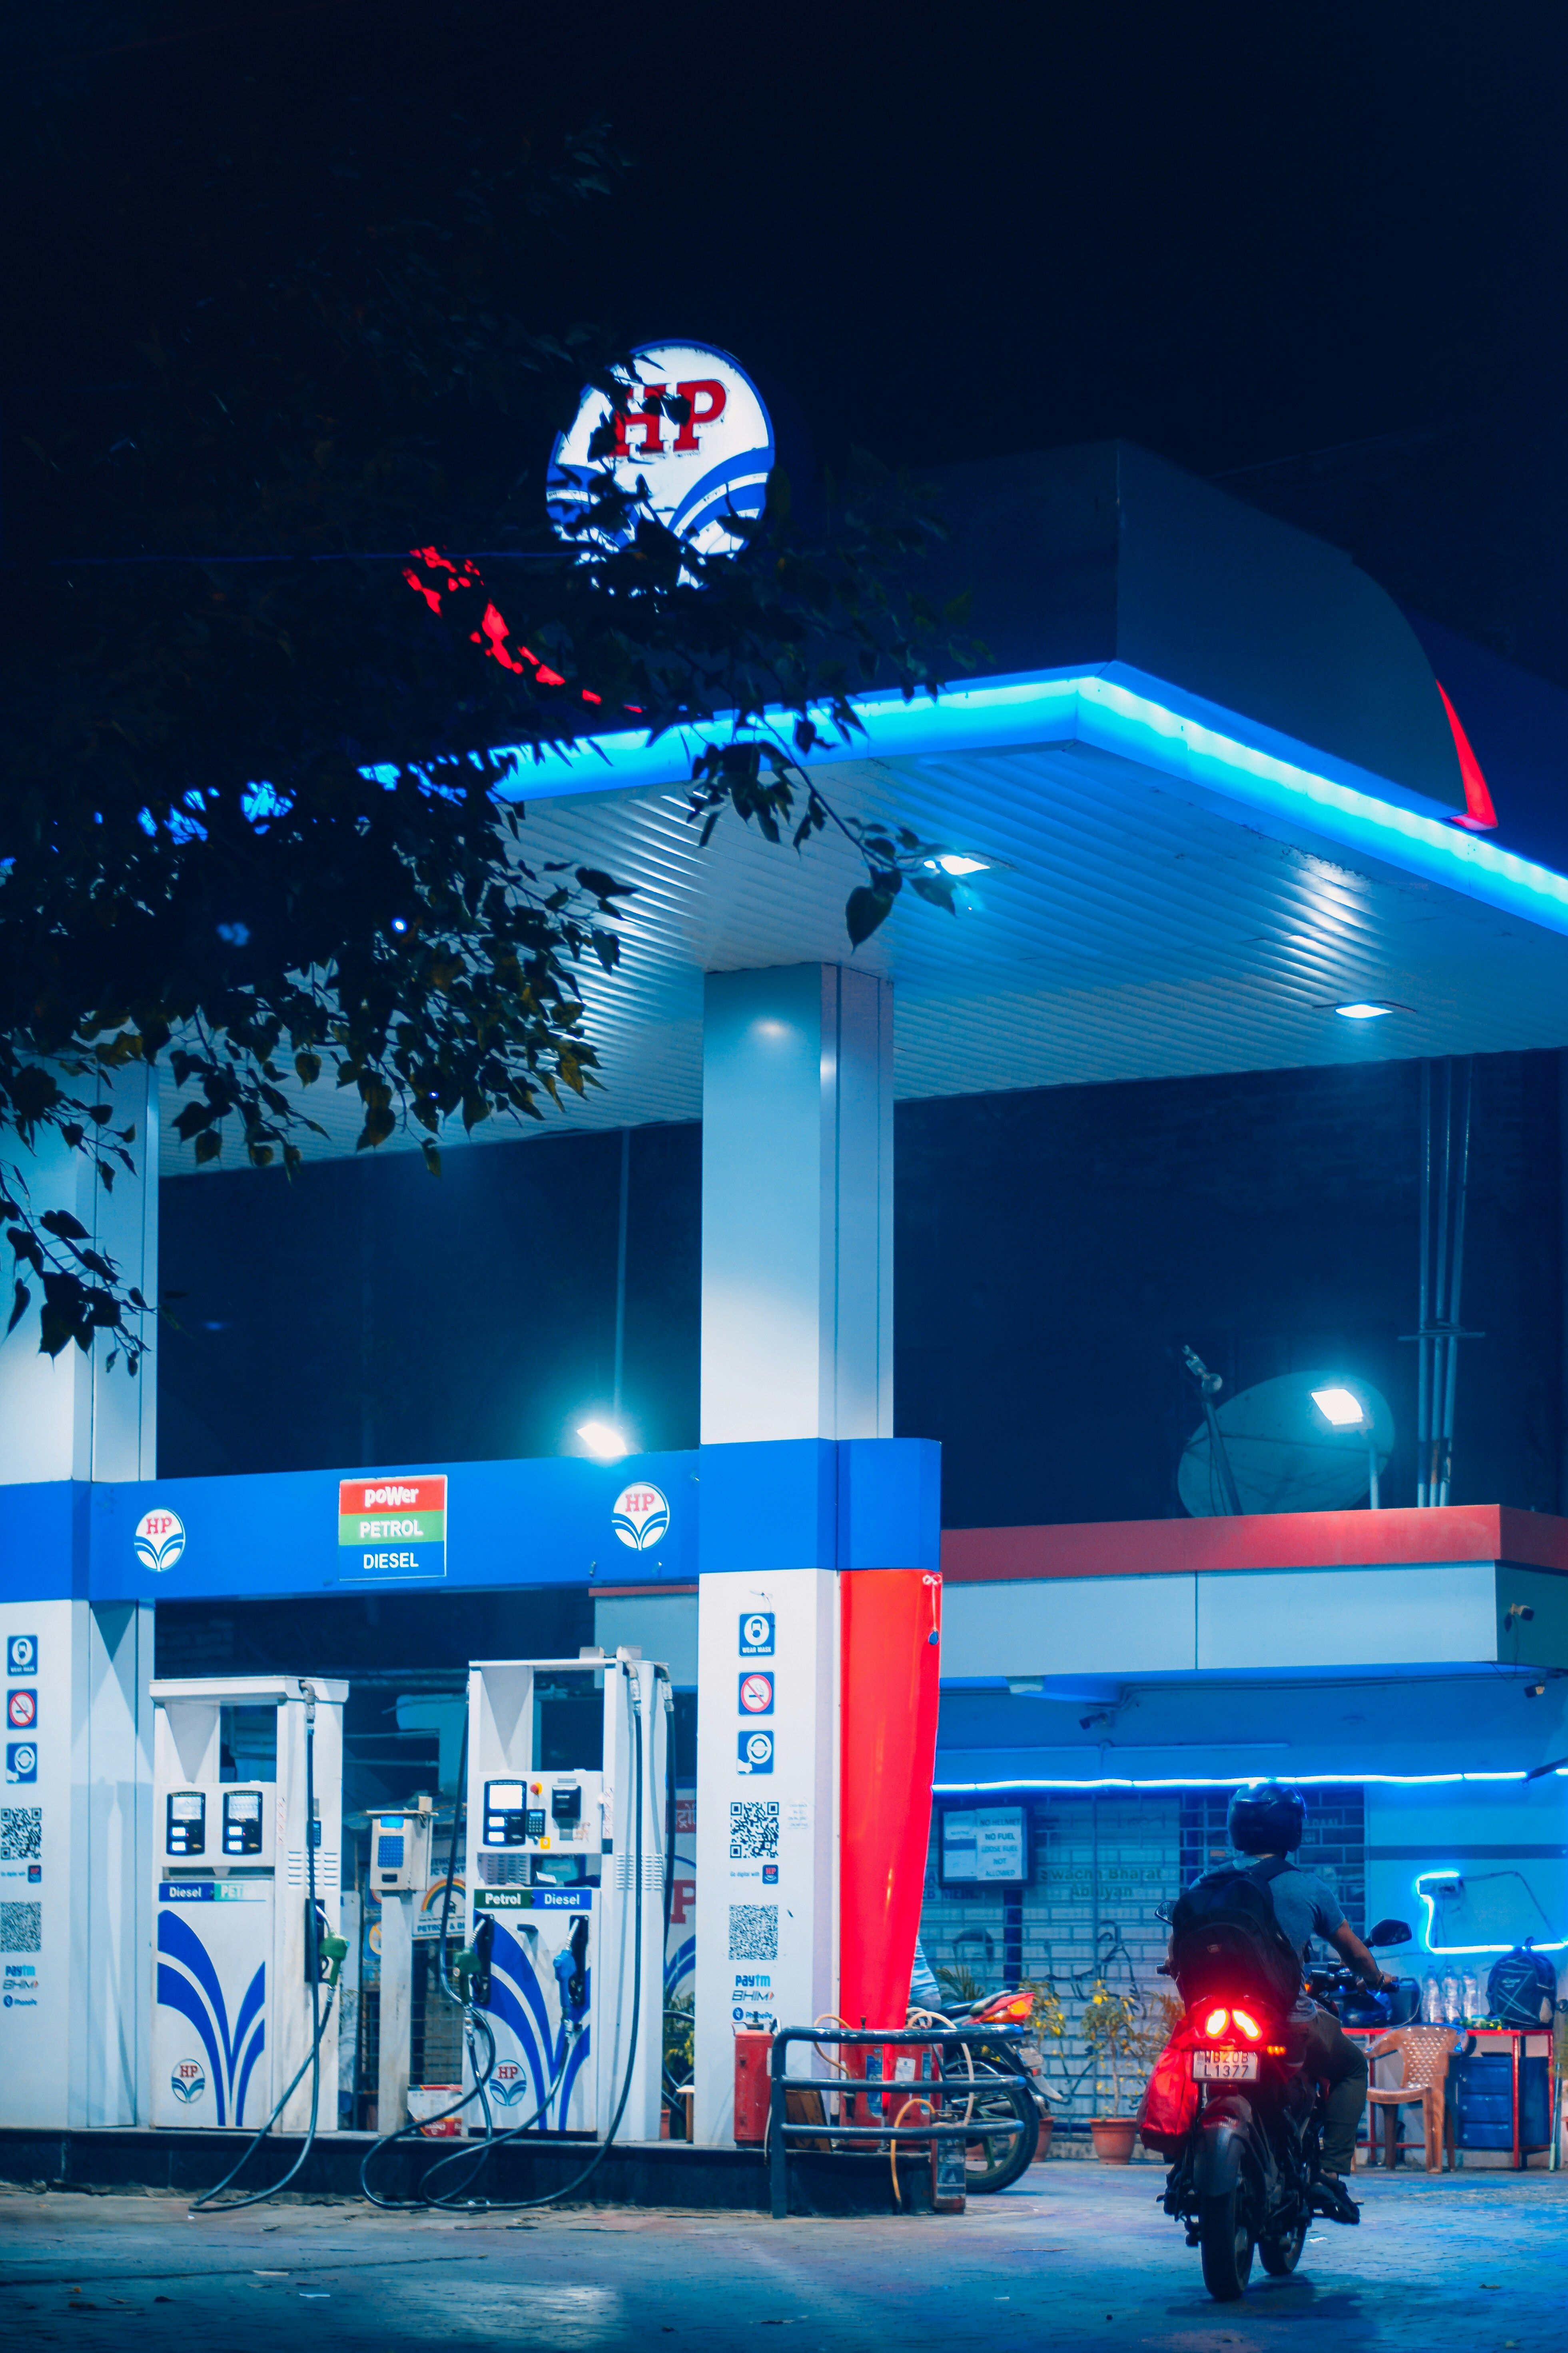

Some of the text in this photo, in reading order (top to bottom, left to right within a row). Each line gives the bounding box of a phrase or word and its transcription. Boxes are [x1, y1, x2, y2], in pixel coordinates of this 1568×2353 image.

[608, 378, 727, 458] HP
[625, 1493, 655, 1512] HP
[146, 1517, 173, 1535] HP
[359, 1519, 424, 1538] PETROL
[363, 1552, 419, 1569] DIESEL
[169, 1887, 201, 1898] Diesel
[485, 1893, 521, 1905] Petrol
[544, 1893, 580, 1905] Diesel
[180, 2065, 198, 2078] HP
[497, 2066, 518, 2079] HP
